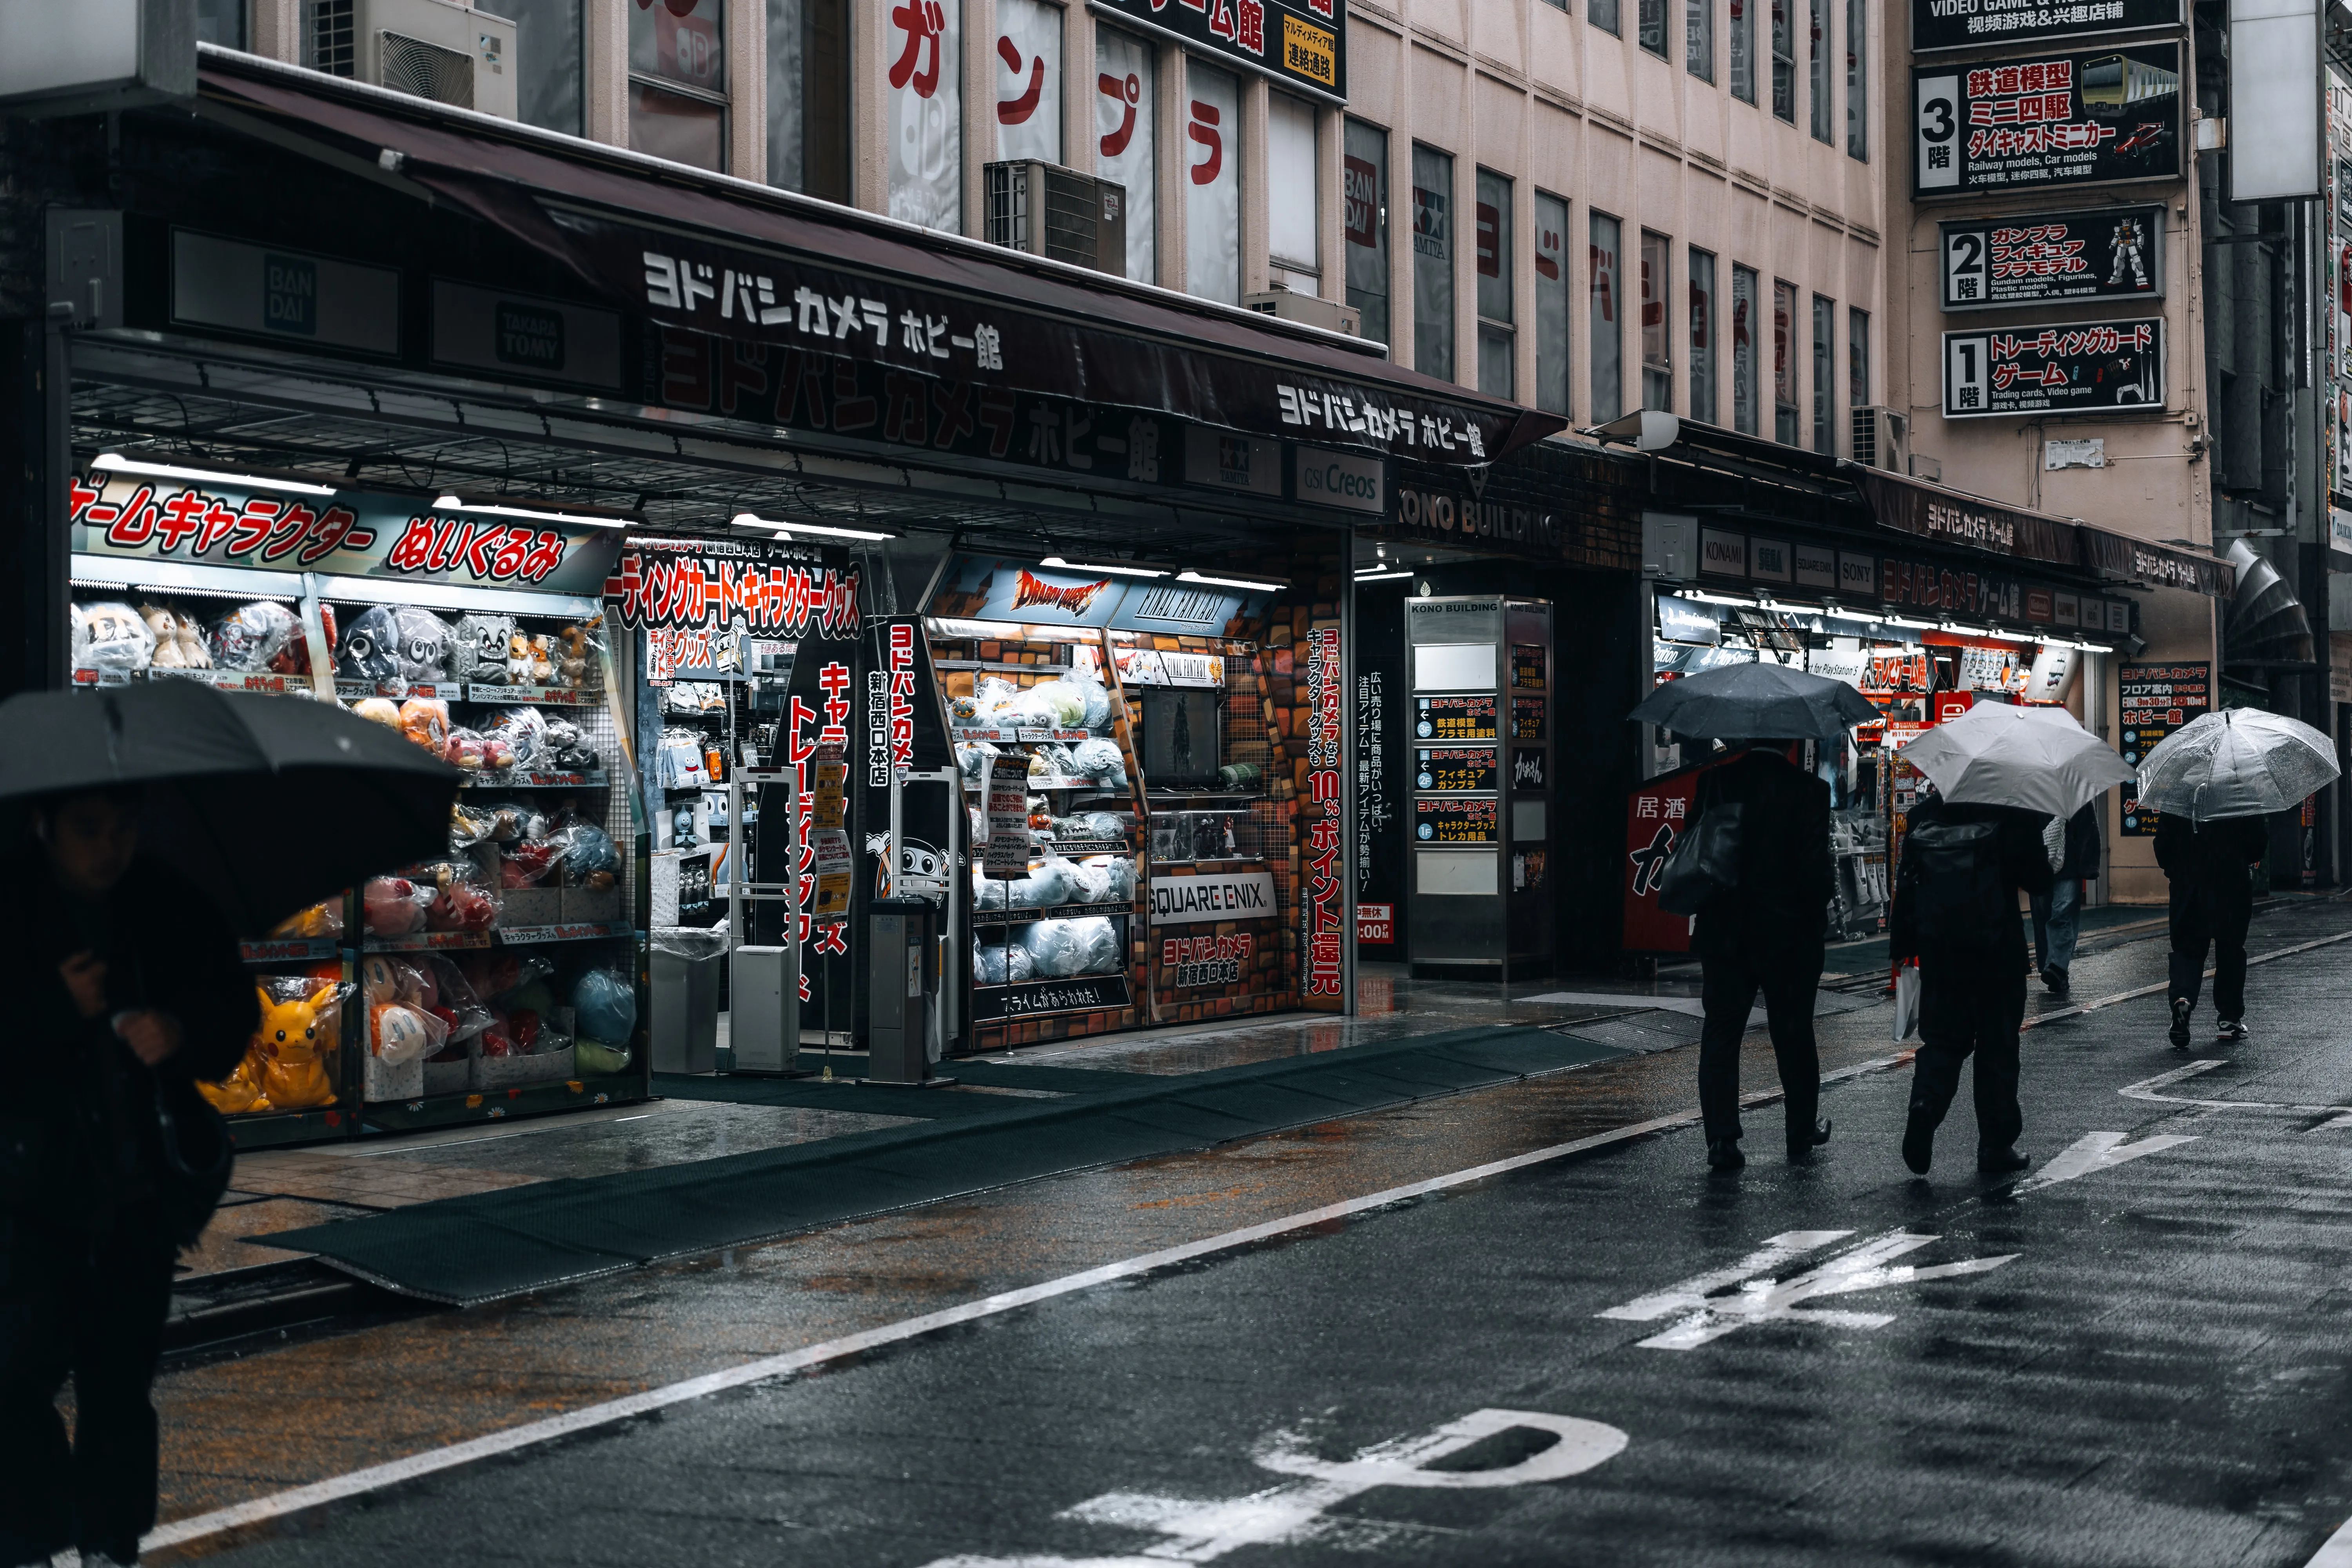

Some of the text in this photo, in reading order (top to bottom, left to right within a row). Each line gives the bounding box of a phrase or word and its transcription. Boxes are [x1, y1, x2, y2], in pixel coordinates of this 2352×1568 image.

[1931, 0, 1978, 16] VIDEO
[1967, 2, 2124, 34] 视频游戏&兴趣店铺
[1289, 42, 1330, 81] 連絡通路
[1967, 60, 2073, 98] 鉄道模型
[1968, 91, 2072, 127] ミニ四駆
[1967, 120, 2116, 158] ダイキャストミニカー
[1968, 151, 2098, 171] Railway models, Car models
[1345, 168, 1373, 205] BAN
[1345, 204, 1367, 234] DAI
[1990, 224, 2067, 245] ガンプラ
[1413, 234, 1446, 260] AMIYA
[1992, 240, 2085, 261] フィギュア
[1991, 272, 2097, 286] Gundam models, Figurines,
[1992, 257, 2088, 279] プラモデル
[269, 265, 312, 297] BAN
[269, 293, 303, 323] DAI
[643, 251, 1003, 370] ヨドバシカメラ ホビー館
[503, 312, 558, 338] TAKARA
[503, 334, 559, 360] TOMY
[1991, 324, 2151, 361] トレーディングカード
[1992, 361, 2068, 390] ゲーム
[1991, 387, 2092, 400] Trading cards, Video game
[1277, 384, 1486, 458] ヨドバシカメラ ホビー館
[1029, 400, 1160, 483] ホビー館
[1220, 469, 1250, 485] TAMIYA
[1305, 463, 1377, 500] GSI Creos
[71, 472, 375, 564] ゲームキャラクター
[1399, 489, 1562, 548] ONO BUILDING
[1928, 503, 2014, 547] ヨドバシカメラ ゲーム館
[2336, 522, 2352, 540] DAIKIN
[391, 515, 565, 583] ぬいぐるみ
[706, 536, 761, 557] 新宿西口本店
[1706, 541, 1741, 564] KONAMI
[1758, 548, 1783, 573] SEGA
[1798, 558, 1820, 572] SQUARE
[2136, 550, 2176, 580] ヨドバシカメラ
[1843, 562, 1871, 582] SONY
[1011, 567, 1060, 612] DRAGON
[1884, 558, 1978, 612] ヨドバシカメラ
[1979, 577, 2020, 619] ゲーム館
[1136, 583, 1229, 622] FINAL FANTASY
[1412, 603, 1498, 613] KONO BUILDING
[1510, 603, 1546, 614] KONO BUILDING
[1167, 658, 1206, 677] FINAL FANTASY
[2122, 667, 2207, 681] ヨドバシカメラ
[1307, 628, 1322, 766] キャラクターグッズも
[1323, 628, 1339, 766] ヨドバシカメラなら
[2122, 684, 2172, 695] フロア案内
[891, 624, 914, 786] ヨドバシカメ
[1431, 698, 1493, 708] ヨドバシカメラ
[1437, 718, 1476, 728] 鉄道模型
[1520, 719, 1540, 728] フィギュア
[2123, 708, 2183, 725] ホビー館
[868, 671, 888, 787] 新宿西口本店
[1419, 725, 1430, 734] 3F
[1437, 728, 1496, 738] プラモ用塗料
[1520, 729, 1536, 738] ガンプラ
[1432, 750, 1493, 760] ヨドバシカメラ
[1467, 759, 1496, 768] ホビー館
[1419, 776, 1430, 785] 2F
[1438, 769, 1485, 779] フィギュア
[1438, 780, 1476, 789] ガンプラ
[1418, 801, 1496, 812] ヨドバシカメラ
[1468, 812, 1496, 820] ホビー館
[1637, 797, 1686, 819] 居酒
[1421, 827, 1430, 835] 1F
[1438, 821, 1495, 830] キャラクターグッズ
[1440, 831, 1486, 841] トレカ用品
[1224, 883, 1264, 909] ENIX
[1163, 933, 1251, 966] ヨドバシカメラ
[1176, 959, 1240, 988] 新宿西口本店
